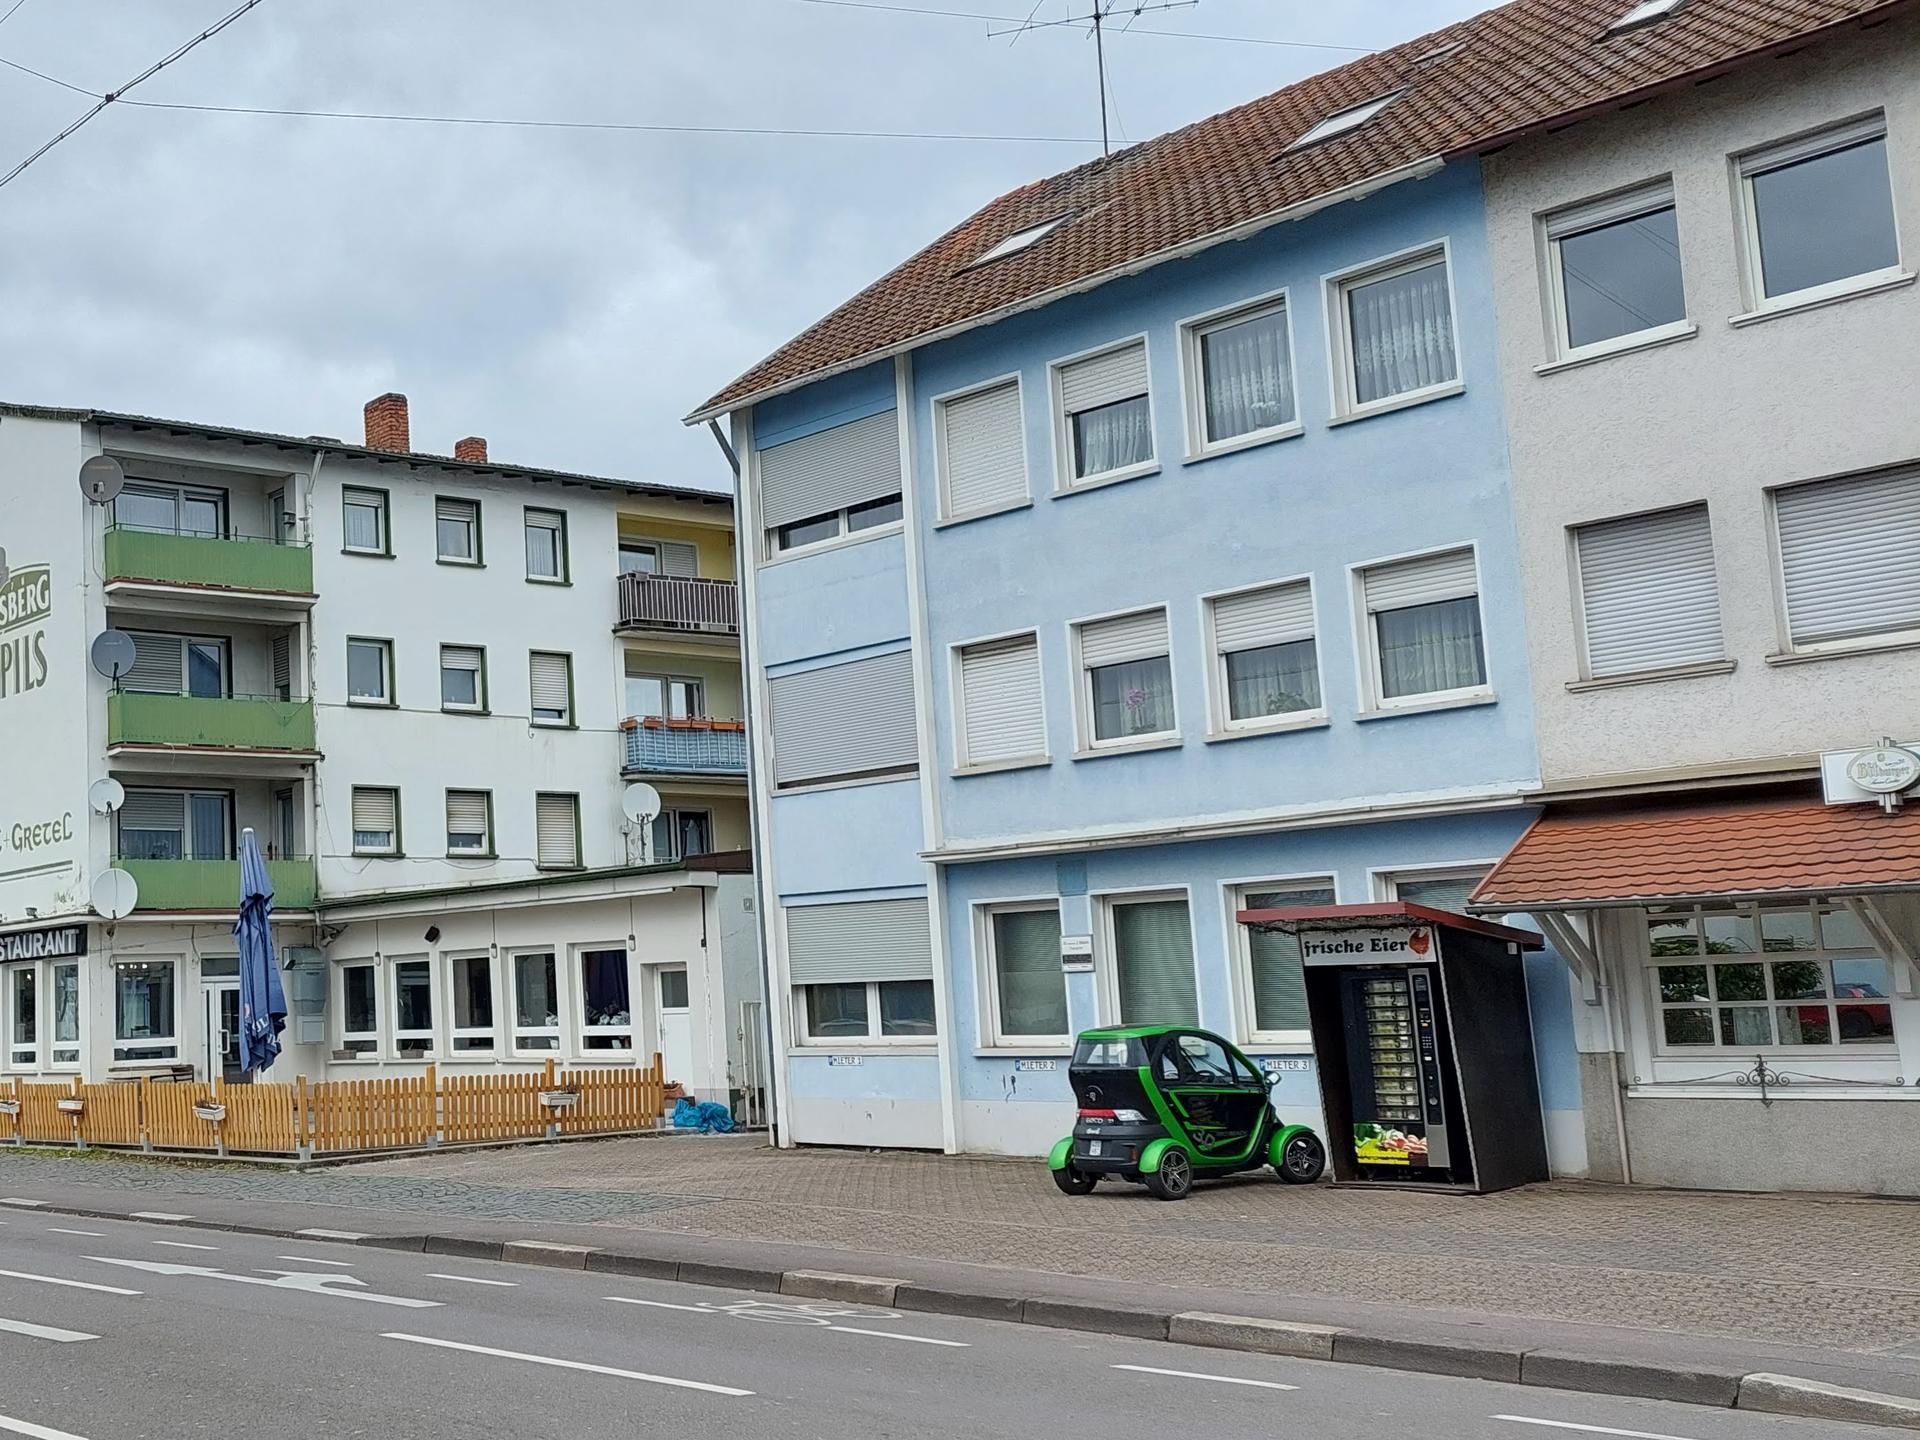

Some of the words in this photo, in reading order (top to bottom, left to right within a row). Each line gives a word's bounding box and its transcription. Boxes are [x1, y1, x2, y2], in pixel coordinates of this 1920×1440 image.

[0, 630, 48, 699] PILS
[1304, 939, 1365, 957] frische
[1370, 938, 1408, 952] Eier
[1021, 1060, 1049, 1070] MIETER
[1266, 1060, 1300, 1070] MIETER
[1302, 1060, 1308, 1070] 3
